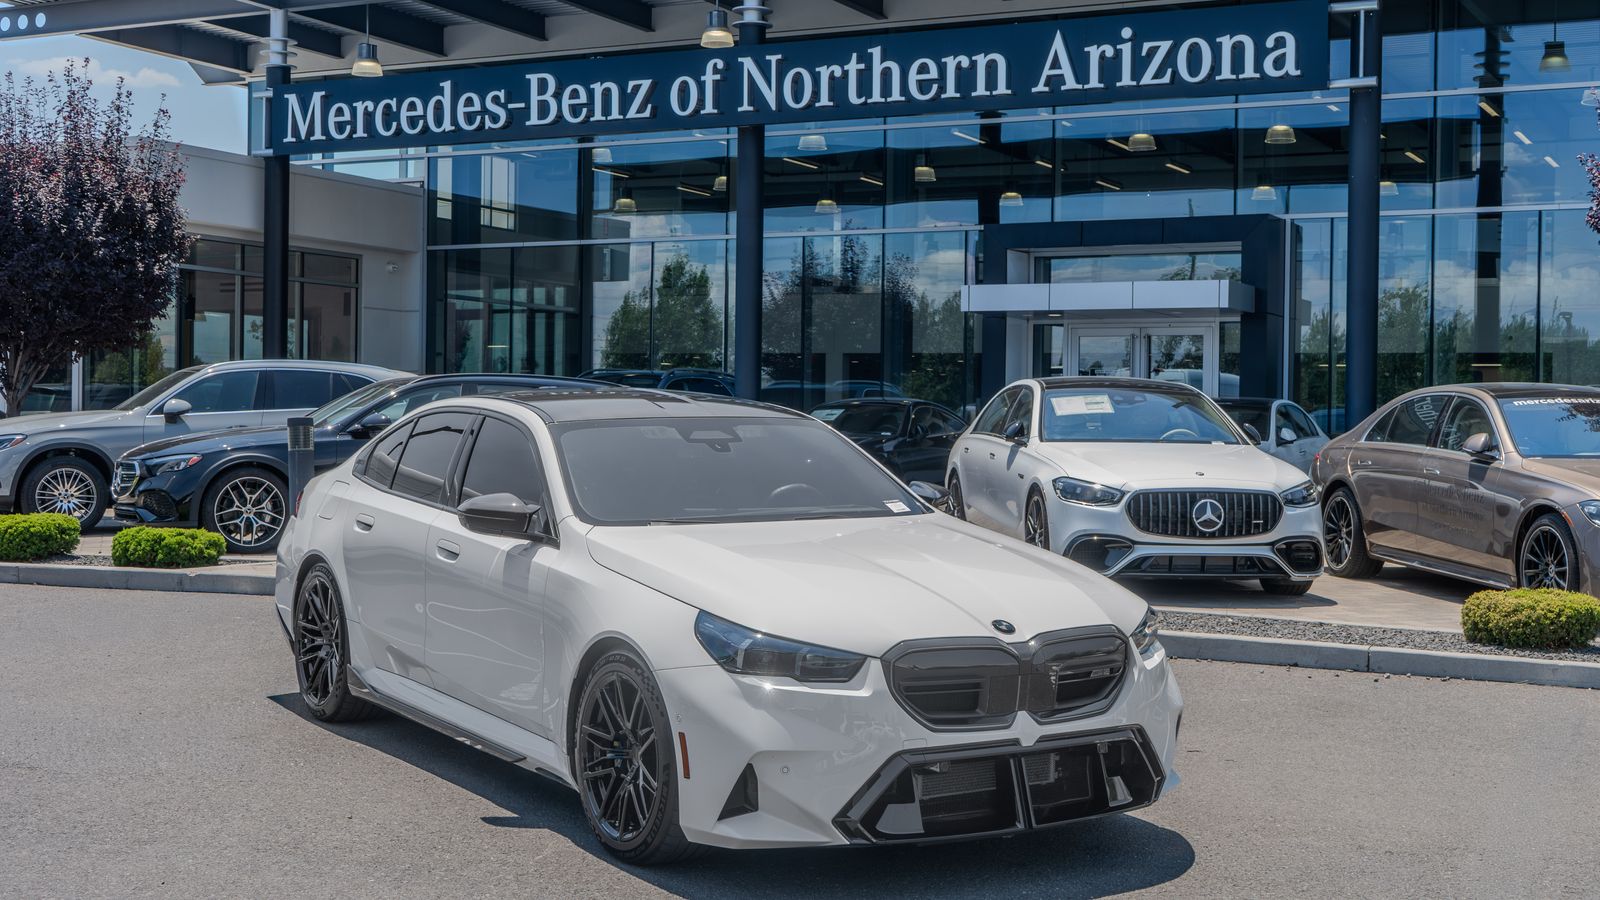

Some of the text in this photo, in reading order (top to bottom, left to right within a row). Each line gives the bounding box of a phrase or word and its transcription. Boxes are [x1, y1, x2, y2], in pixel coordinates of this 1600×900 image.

[283, 26, 1301, 143] Mercedes-Benz of Northern Arizona
